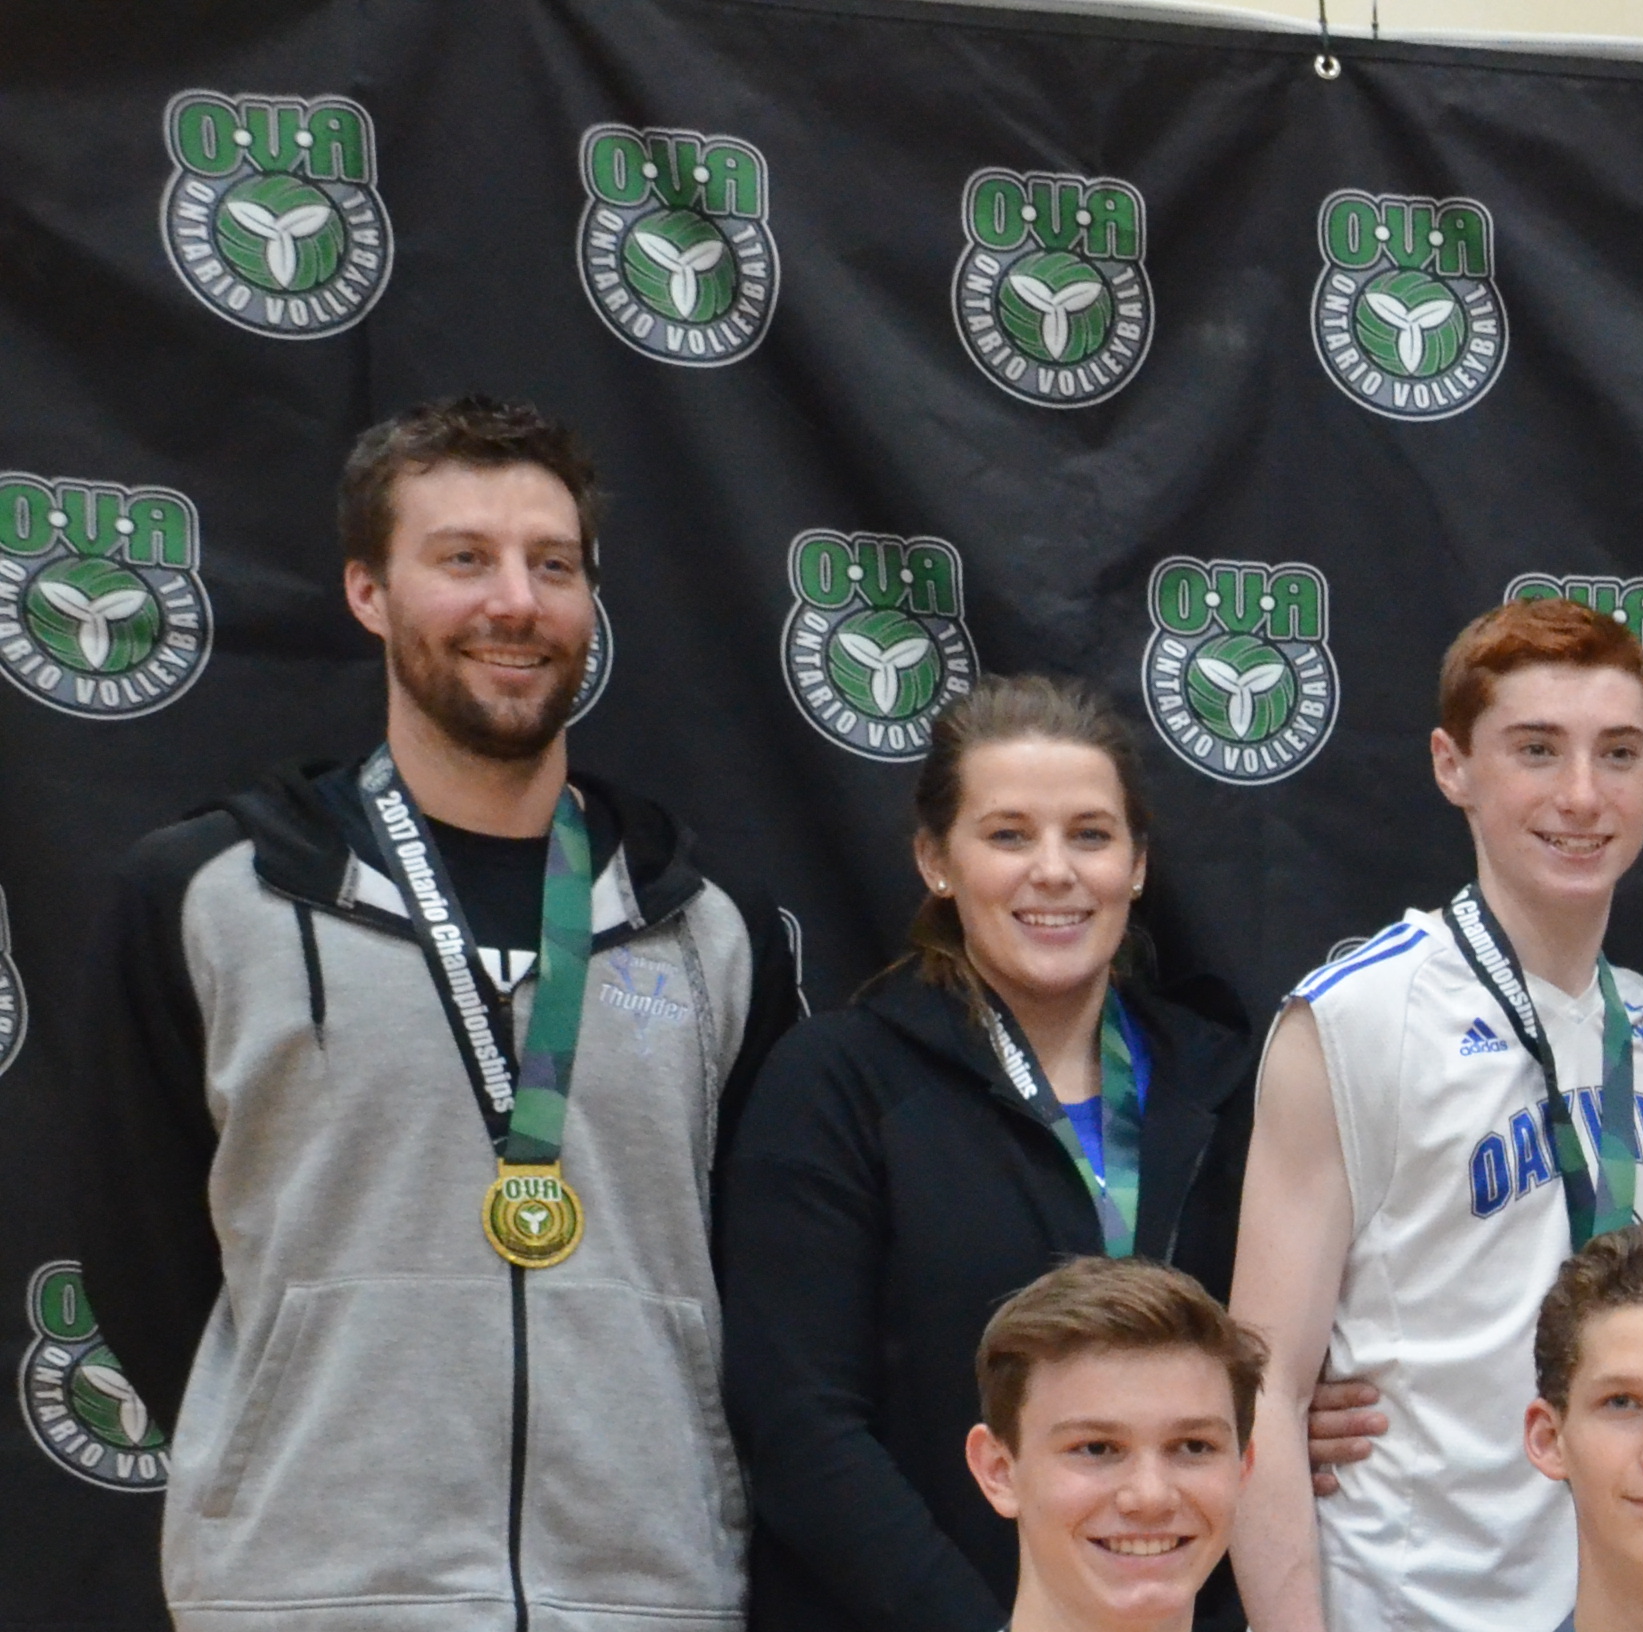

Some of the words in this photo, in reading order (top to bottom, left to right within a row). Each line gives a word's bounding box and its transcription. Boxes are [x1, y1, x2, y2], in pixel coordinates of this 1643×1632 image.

[175, 99, 371, 184] OVA
[590, 131, 759, 215] OVA
[172, 181, 250, 313] ONTARIO
[265, 188, 383, 329] VOLLEYBALL
[968, 177, 1136, 257] OVA
[1326, 198, 1490, 275] OVA
[587, 212, 655, 342] ONTARIO
[668, 219, 770, 357] VOLLEYBALL
[964, 257, 1030, 382] ONTARIO
[1039, 260, 1144, 396] VOLLEYBALL
[1322, 275, 1386, 396] ONTARIO
[1395, 278, 1498, 410] VOLLEYBALL
[799, 539, 960, 616] OVA
[1157, 565, 1321, 641] OVA
[76, 573, 200, 709] VOLLEYBALL
[795, 609, 856, 730] ONTARIO
[1153, 641, 1217, 760] ONTARIO
[1226, 644, 1329, 774] VOLLEYBALL
[376, 791, 415, 843] 2017
[396, 841, 449, 925] Ontario
[431, 923, 515, 1114] Championships
[600, 983, 688, 1022] Thunder
[503, 1175, 562, 1201] OVA
[36, 1346, 104, 1468] ONTARIO
